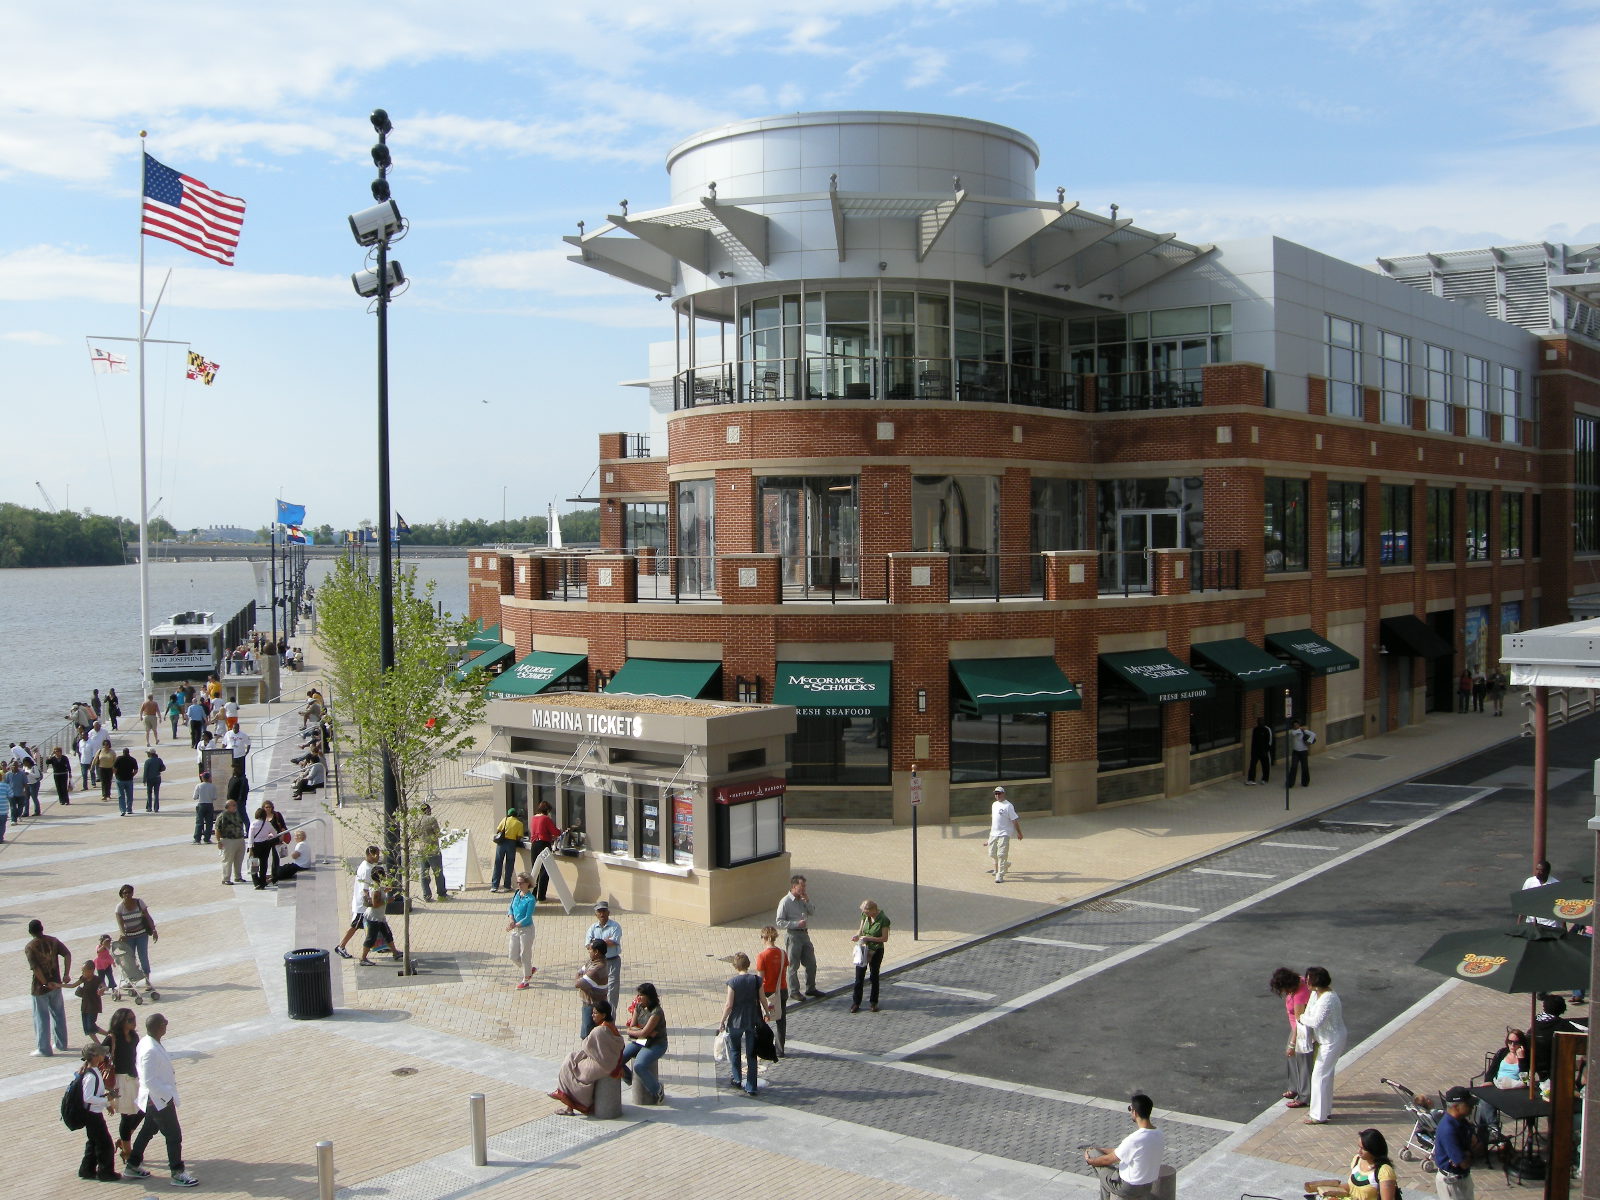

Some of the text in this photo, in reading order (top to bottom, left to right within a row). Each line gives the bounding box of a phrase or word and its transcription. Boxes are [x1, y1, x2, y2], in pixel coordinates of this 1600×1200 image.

[811, 683, 876, 692] SCHMICK'S
[1159, 689, 1207, 702] FRESH SEAFOOD
[795, 708, 871, 716] RESH SEAFOOD
[532, 709, 643, 737] MARINA TICKETS
